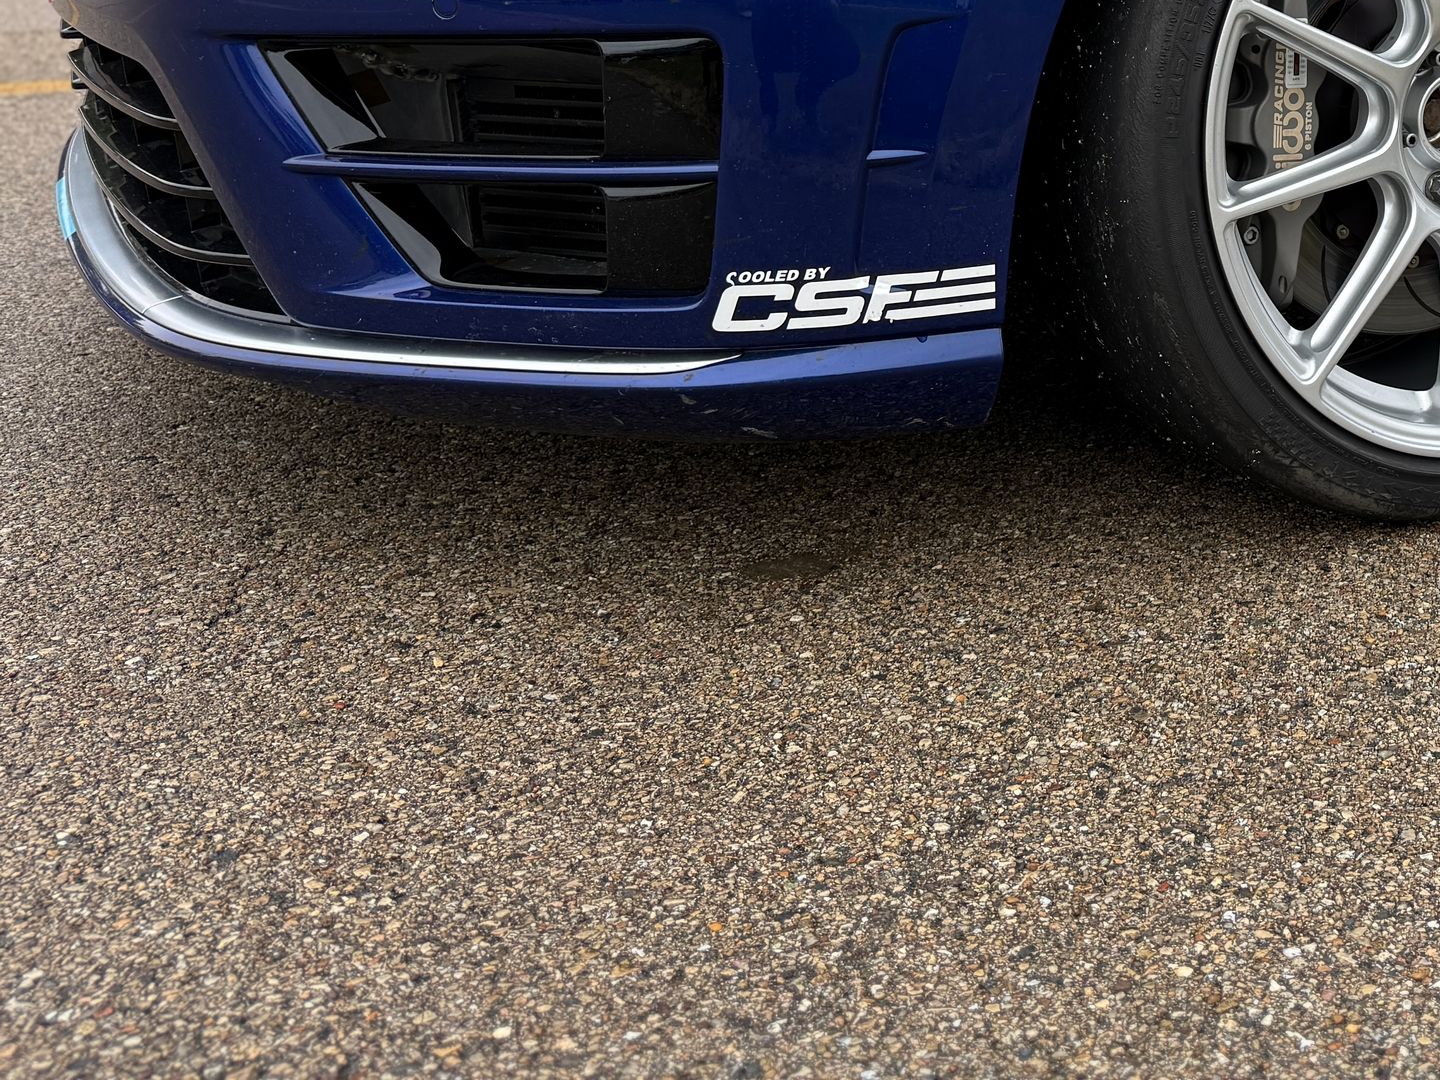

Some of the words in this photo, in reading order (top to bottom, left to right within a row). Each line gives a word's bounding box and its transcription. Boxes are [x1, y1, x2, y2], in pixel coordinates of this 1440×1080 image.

[1273, 51, 1285, 125] RACING
[1305, 101, 1313, 141] PISTON
[1304, 143, 1312, 151] 6
[726, 269, 799, 286] COOLED
[803, 266, 831, 281] BY
[712, 263, 996, 332] CSF
